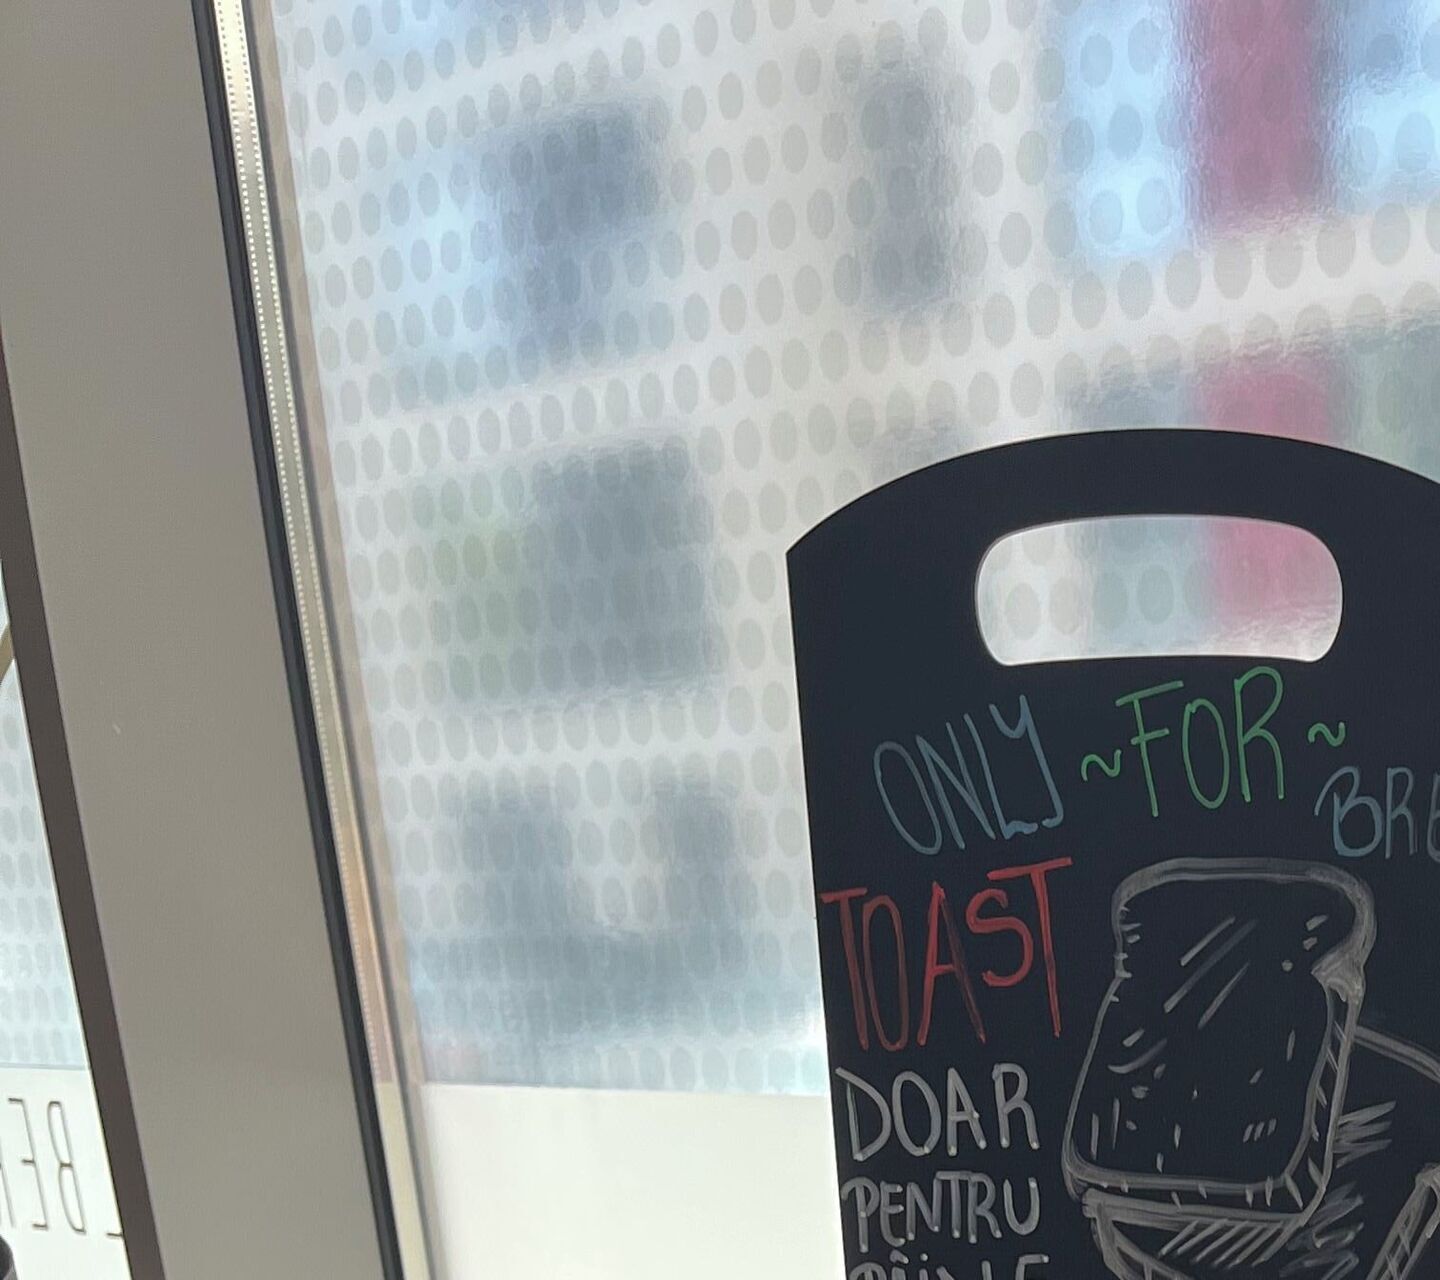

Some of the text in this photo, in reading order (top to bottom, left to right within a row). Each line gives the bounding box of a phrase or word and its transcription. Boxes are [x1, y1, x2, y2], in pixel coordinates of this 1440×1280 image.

[873, 695, 1065, 856] ONLY
[1115, 666, 1286, 819] FOR
[819, 856, 1073, 1052] TOAST
[835, 1062, 1041, 1163] DOAR
[839, 1171, 1041, 1253] PENTRU
